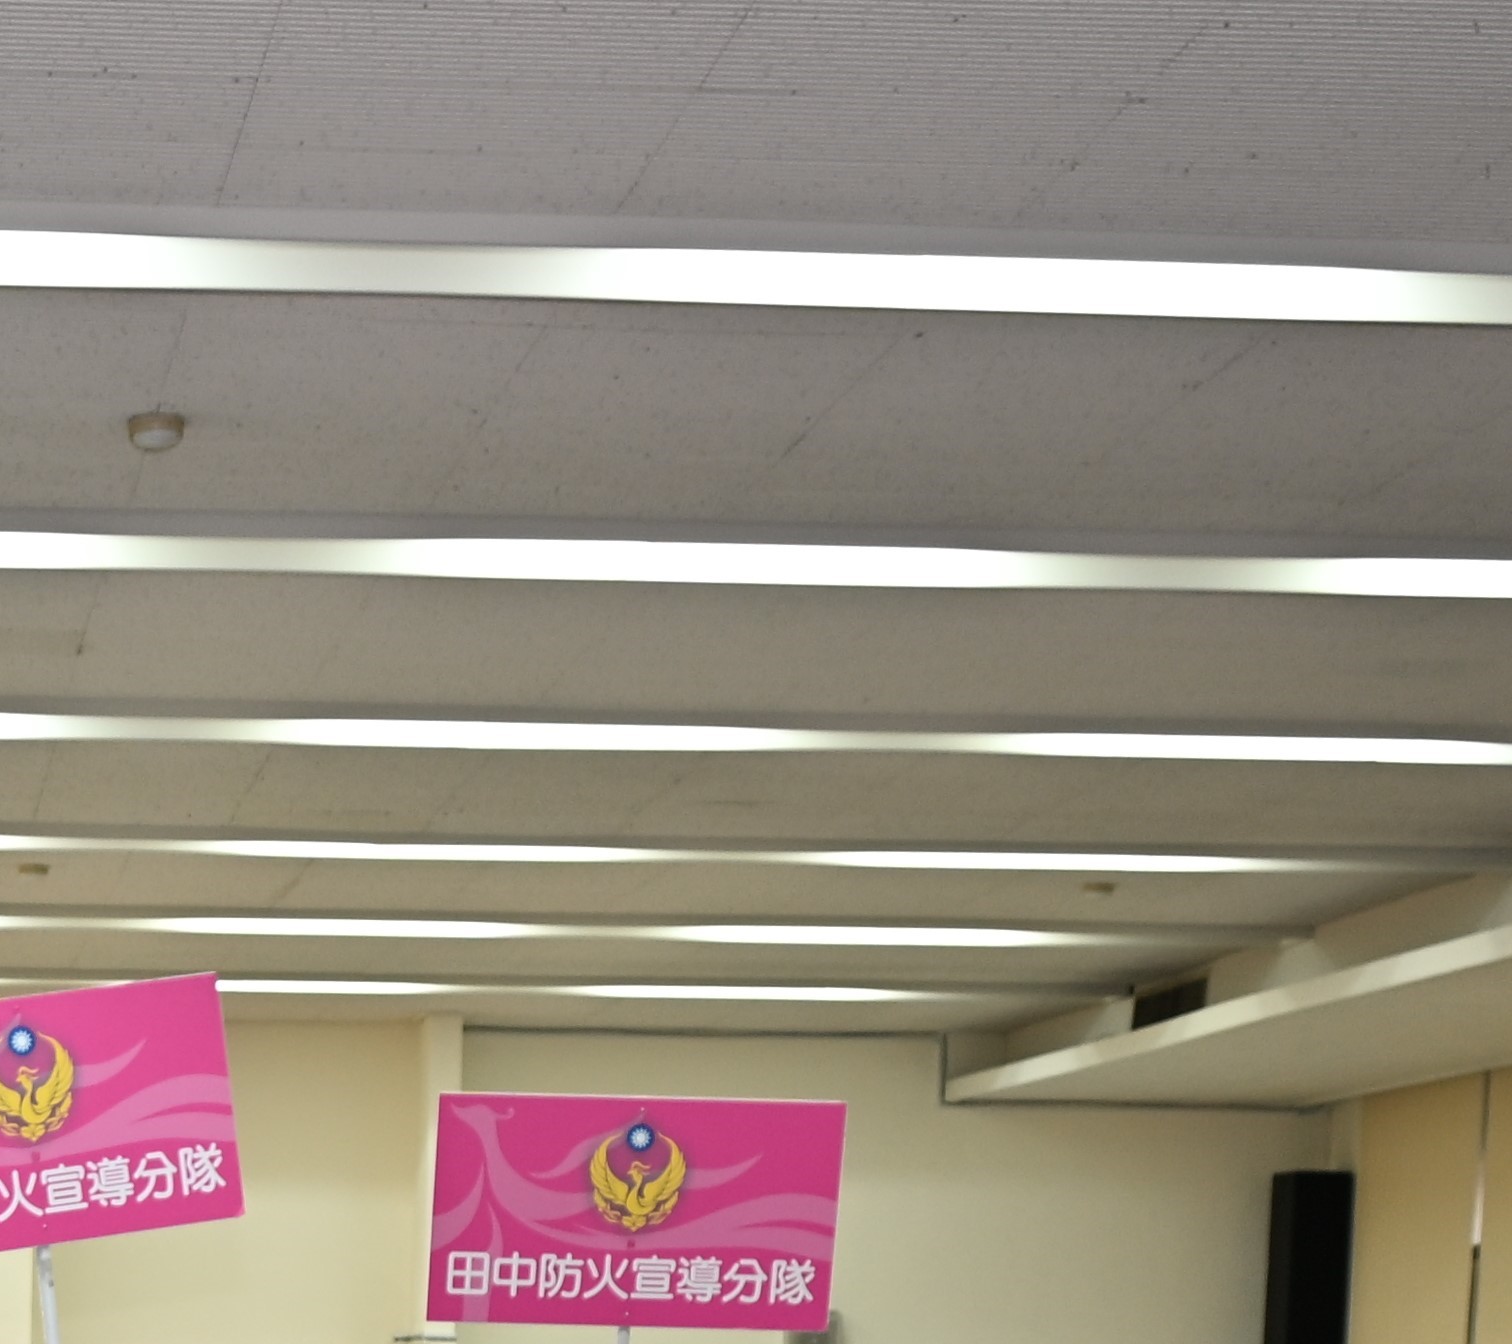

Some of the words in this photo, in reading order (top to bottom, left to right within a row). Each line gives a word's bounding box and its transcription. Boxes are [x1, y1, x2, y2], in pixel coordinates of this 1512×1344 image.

[446, 1251, 815, 1305] 田中防火宣導分隊
